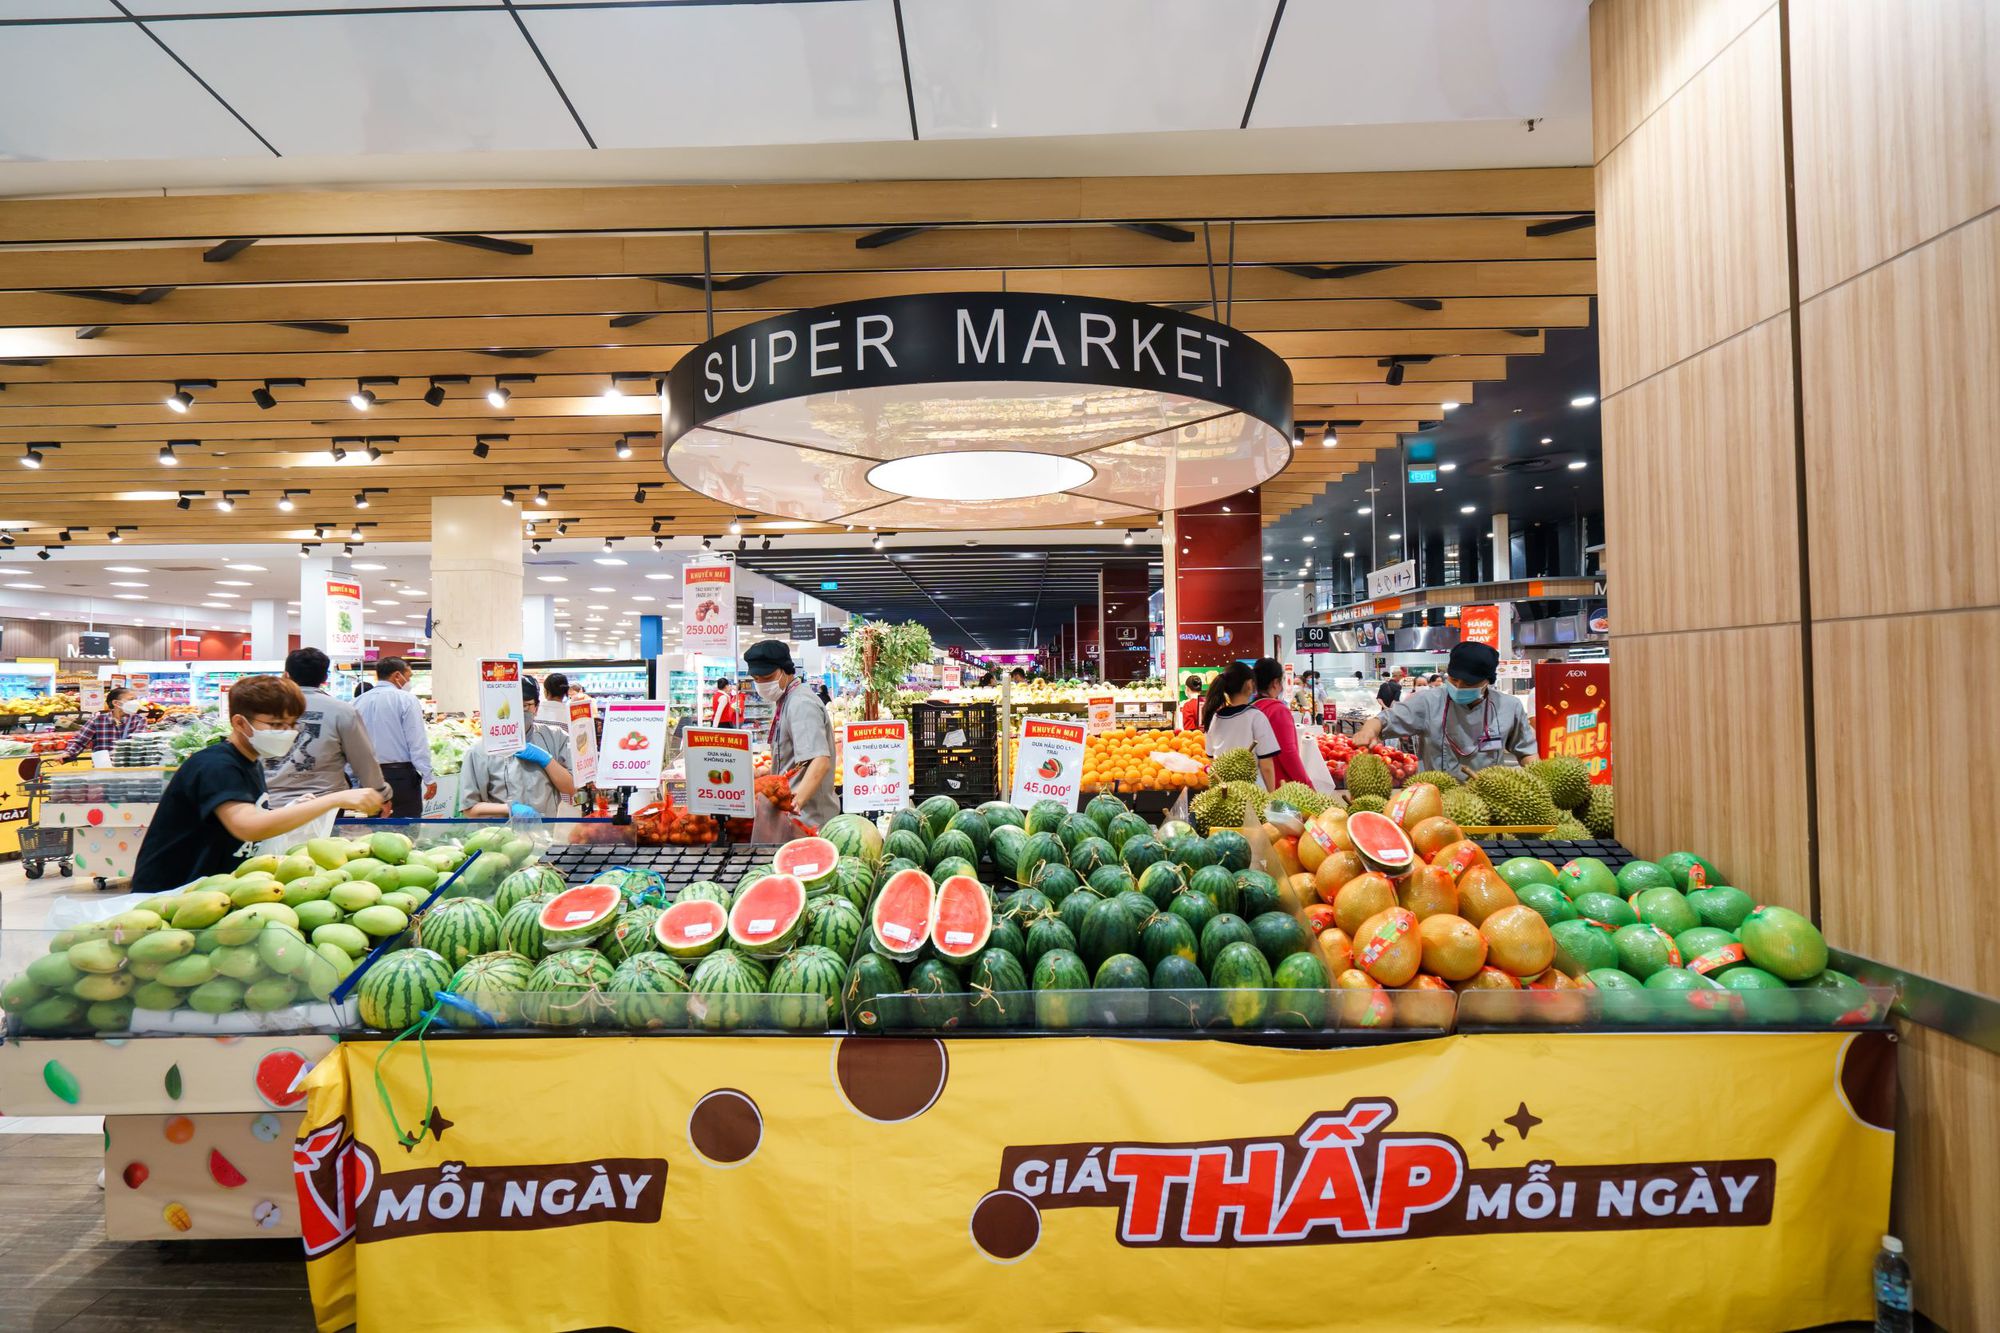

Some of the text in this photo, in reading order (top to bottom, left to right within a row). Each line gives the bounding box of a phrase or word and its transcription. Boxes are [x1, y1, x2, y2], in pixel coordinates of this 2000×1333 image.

[703, 308, 1230, 403] SUPER MARKET
[1414, 472, 1431, 481] EXIT
[1309, 628, 1324, 641] 60
[1031, 724, 1061, 735] KHUYẾN
[1566, 712, 1597, 734] MEGA
[853, 726, 883, 737] KHUYẾN
[693, 734, 725, 743] KHUYẾN
[612, 760, 651, 770] 65.000đ
[697, 788, 746, 801] 25.000đ
[853, 781, 900, 796] 69.000đ
[1023, 781, 1072, 797] 45.000đ
[0, 809, 28, 820] GÀY
[1012, 1102, 1760, 1242] GIÁ THẤP MỖI NGÀY
[372, 1164, 484, 1228] MỖI
[500, 1165, 652, 1218] NGÀY
